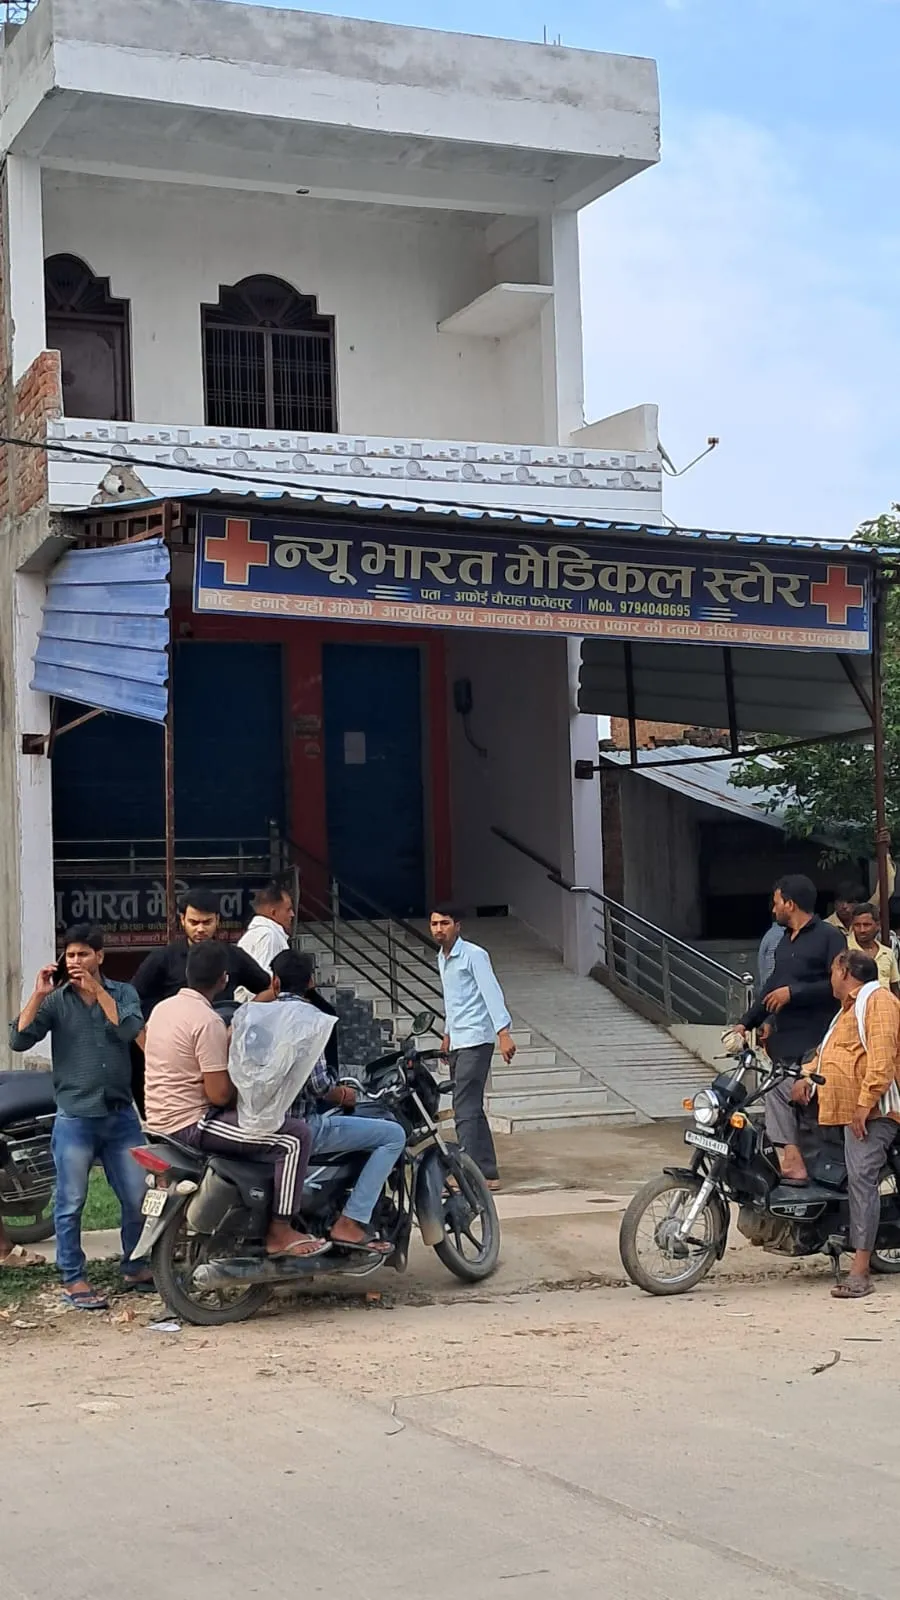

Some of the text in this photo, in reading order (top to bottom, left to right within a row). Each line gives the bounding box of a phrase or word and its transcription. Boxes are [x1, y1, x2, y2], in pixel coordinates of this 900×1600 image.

[272, 535, 358, 585] न्यू
[361, 540, 498, 586] भारत
[504, 544, 696, 599] मेडिकल
[702, 561, 810, 608] स्टोर
[420, 588, 441, 601] पता
[492, 592, 527, 607] चौराहा
[529, 595, 574, 610] फतेहपुर
[588, 598, 691, 617] Mob. 9794048695
[251, 594, 290, 611] हमारे
[456, 608, 475, 623] एवं
[534, 613, 554, 628] की
[557, 616, 600, 631] समस्त
[604, 619, 641, 634] प्रकार
[644, 620, 662, 635] की
[704, 624, 738, 639] उचित
[778, 630, 795, 643] पर
[71, 889, 141, 921] भारत
